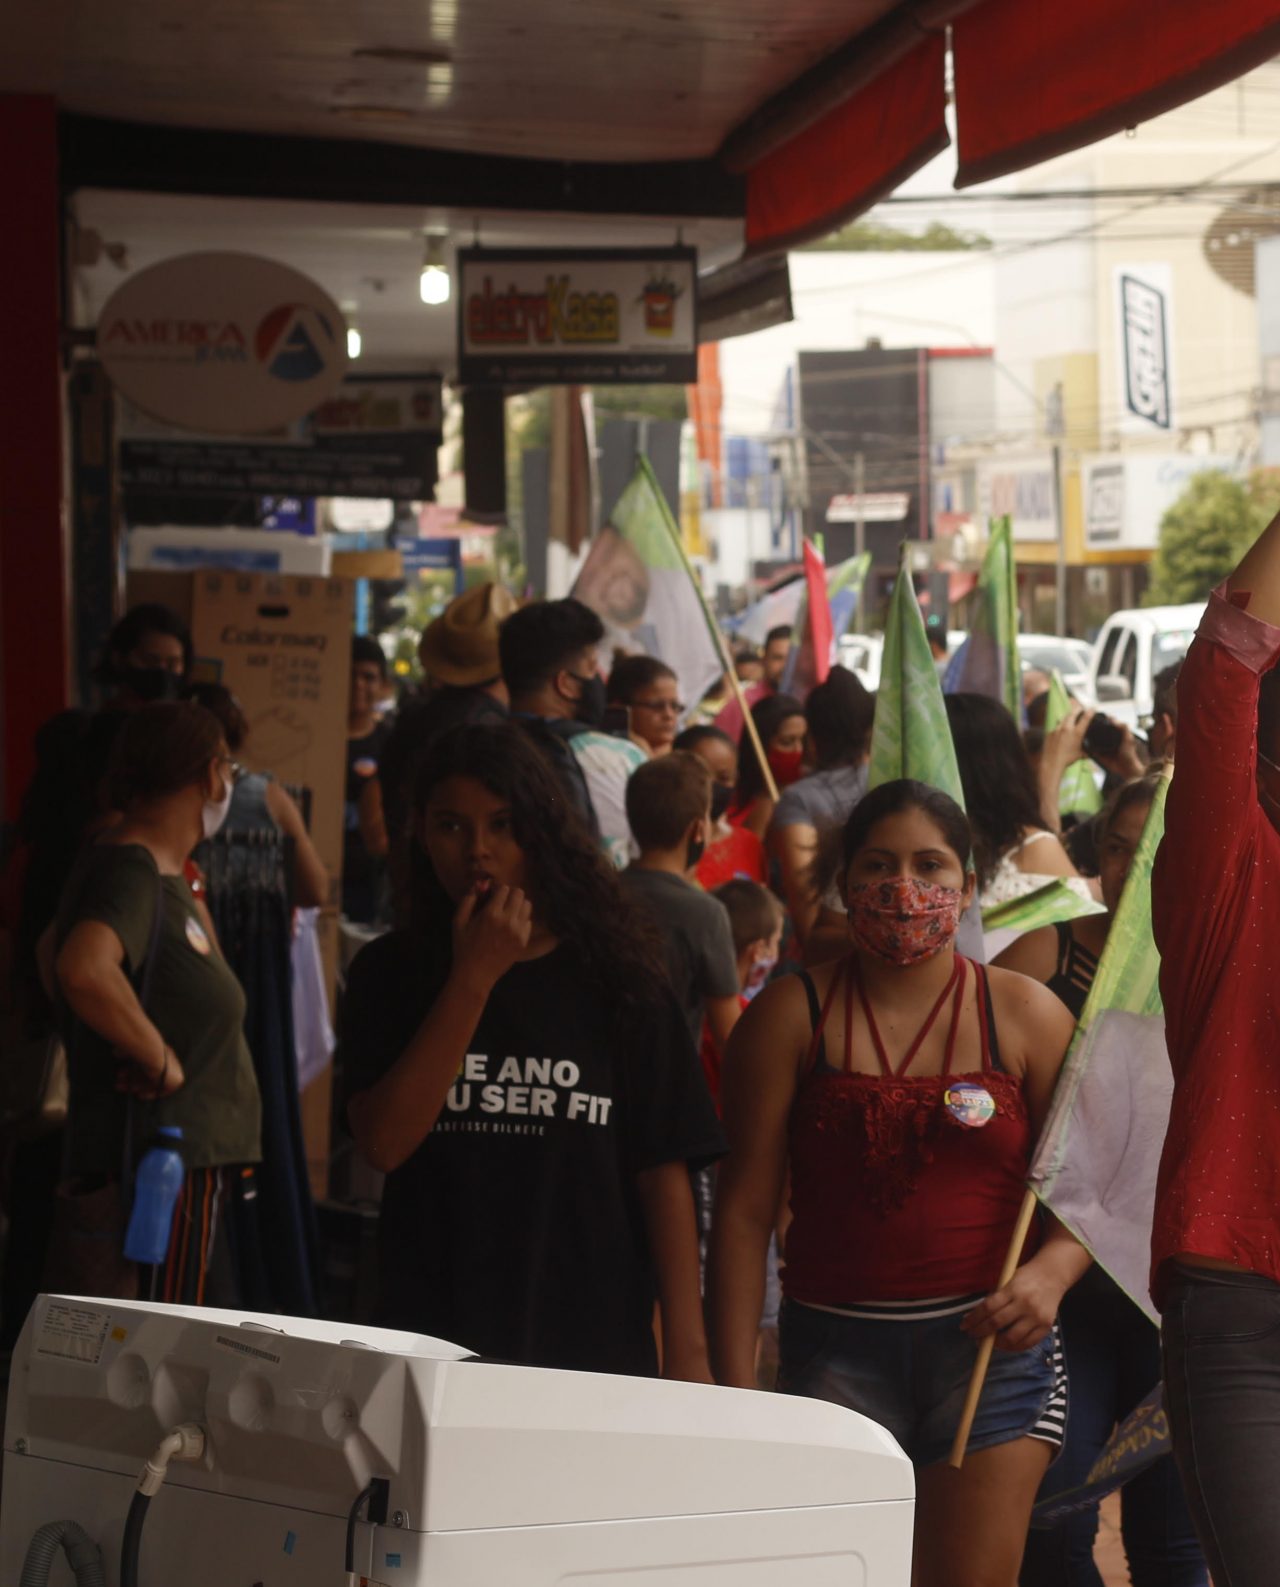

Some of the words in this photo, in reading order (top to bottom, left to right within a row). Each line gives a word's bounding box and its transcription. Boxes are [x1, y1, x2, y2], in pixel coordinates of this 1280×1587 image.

[221, 624, 327, 654] Colormaq
[464, 1054, 488, 1081] E
[497, 1057, 580, 1088] ANO
[446, 1083, 471, 1112] U
[479, 1084, 557, 1116] SER
[567, 1091, 612, 1126] FIT
